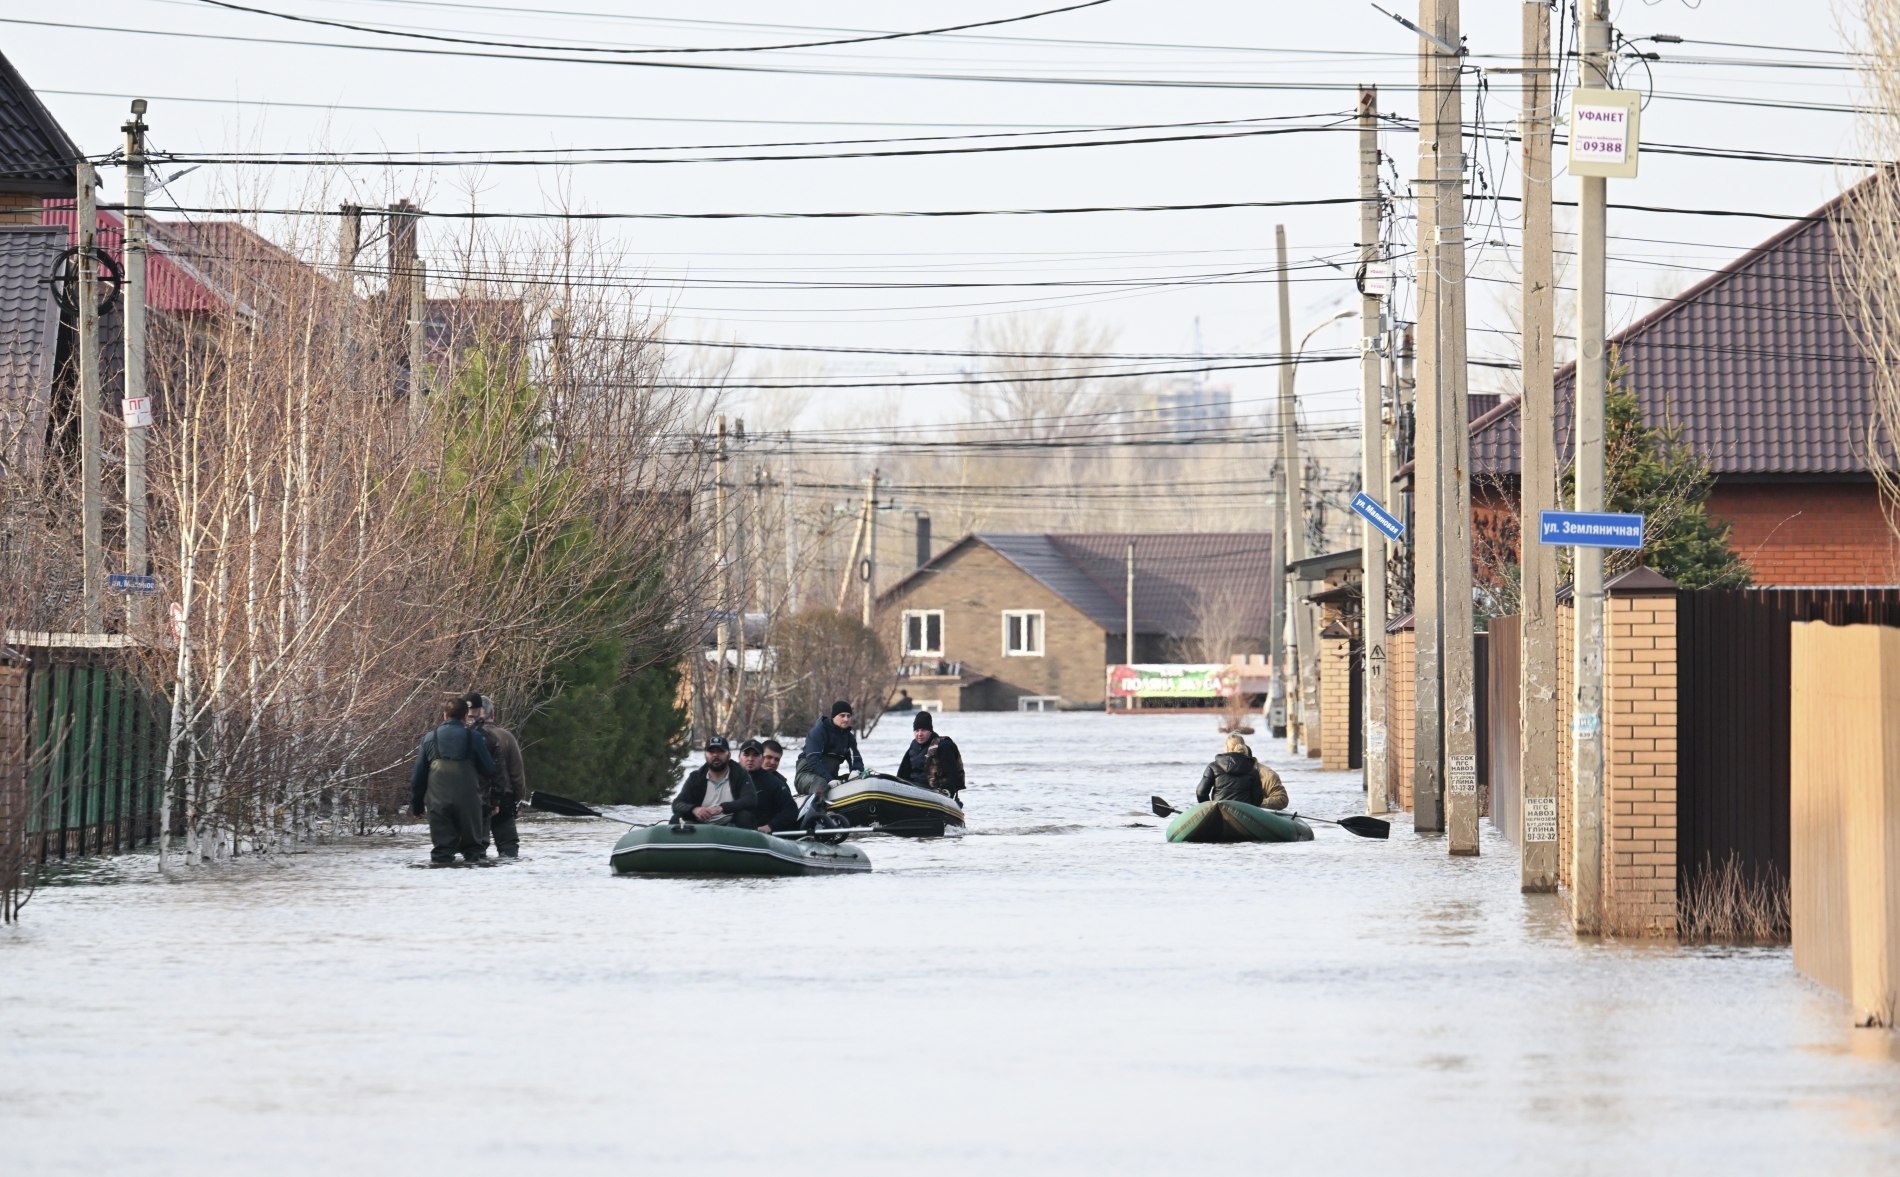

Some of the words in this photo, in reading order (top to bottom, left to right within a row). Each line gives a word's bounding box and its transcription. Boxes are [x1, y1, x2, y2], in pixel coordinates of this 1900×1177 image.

[1578, 111, 1624, 122] УФАНЕТ
[1583, 141, 1622, 152] 09388
[129, 399, 144, 410] ПГ
[1355, 498, 1366, 509] ул.
[1365, 504, 1399, 534] Малиновая
[1543, 522, 1559, 535] ул.
[1562, 521, 1640, 536] Земляничная
[1371, 665, 1380, 676] 11
[1121, 677, 1175, 691] ПОЛЯНА
